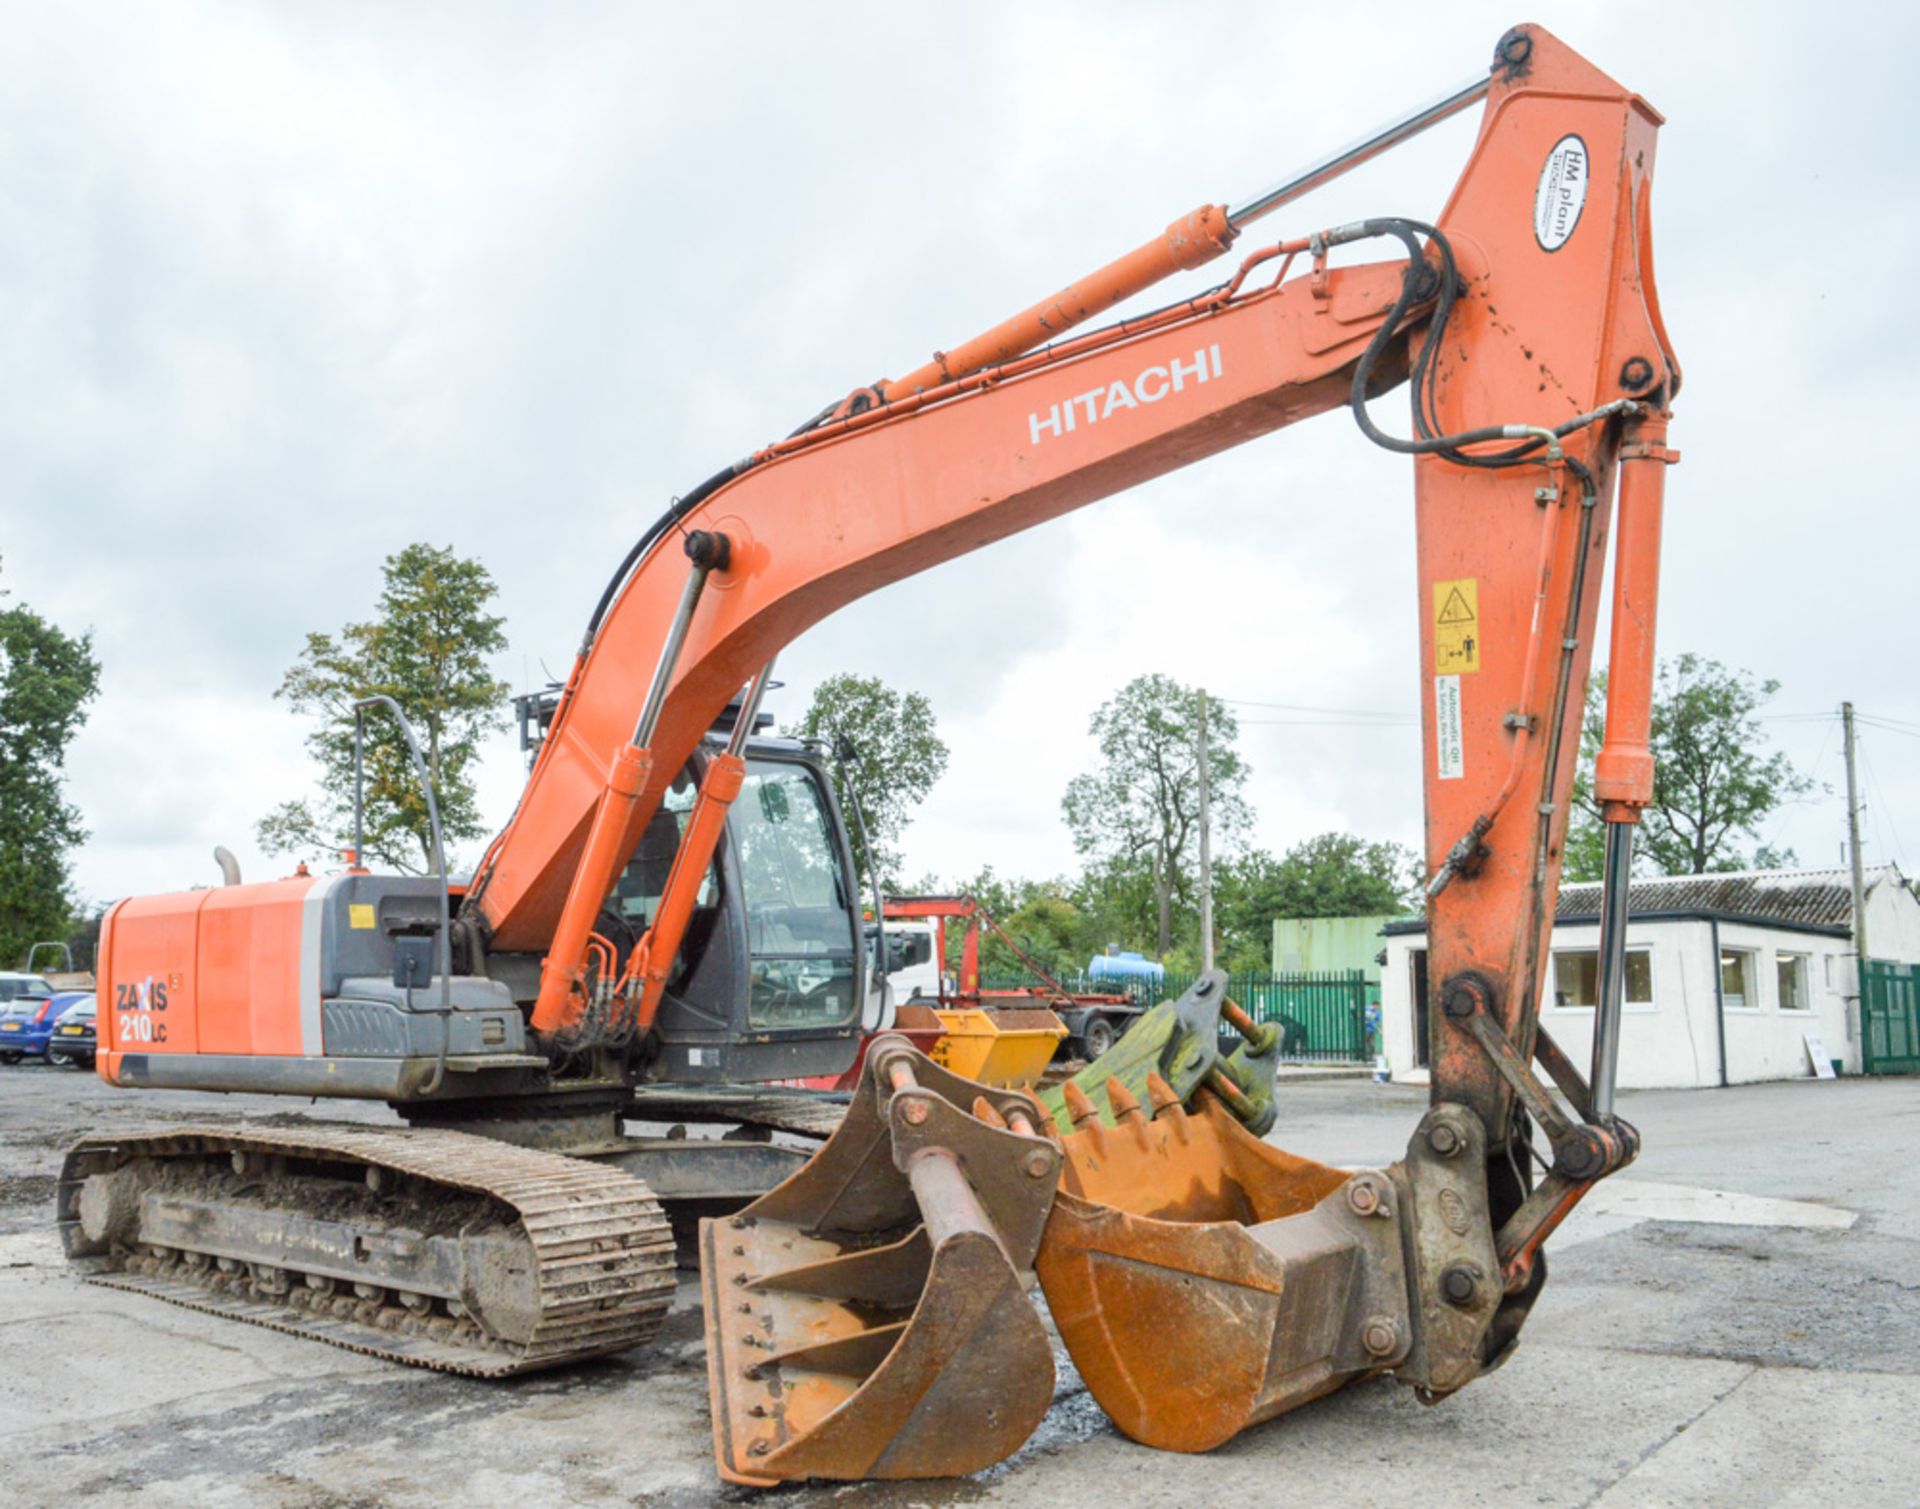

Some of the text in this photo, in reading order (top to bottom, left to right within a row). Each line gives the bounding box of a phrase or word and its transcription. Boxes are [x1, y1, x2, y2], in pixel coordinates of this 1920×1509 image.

[1564, 149, 1583, 182] HM
[1555, 187, 1574, 238] plant
[1028, 343, 1224, 445] HITACHI
[1448, 686, 1460, 764] Automatic QH
[116, 976, 168, 1012] ZAXIS
